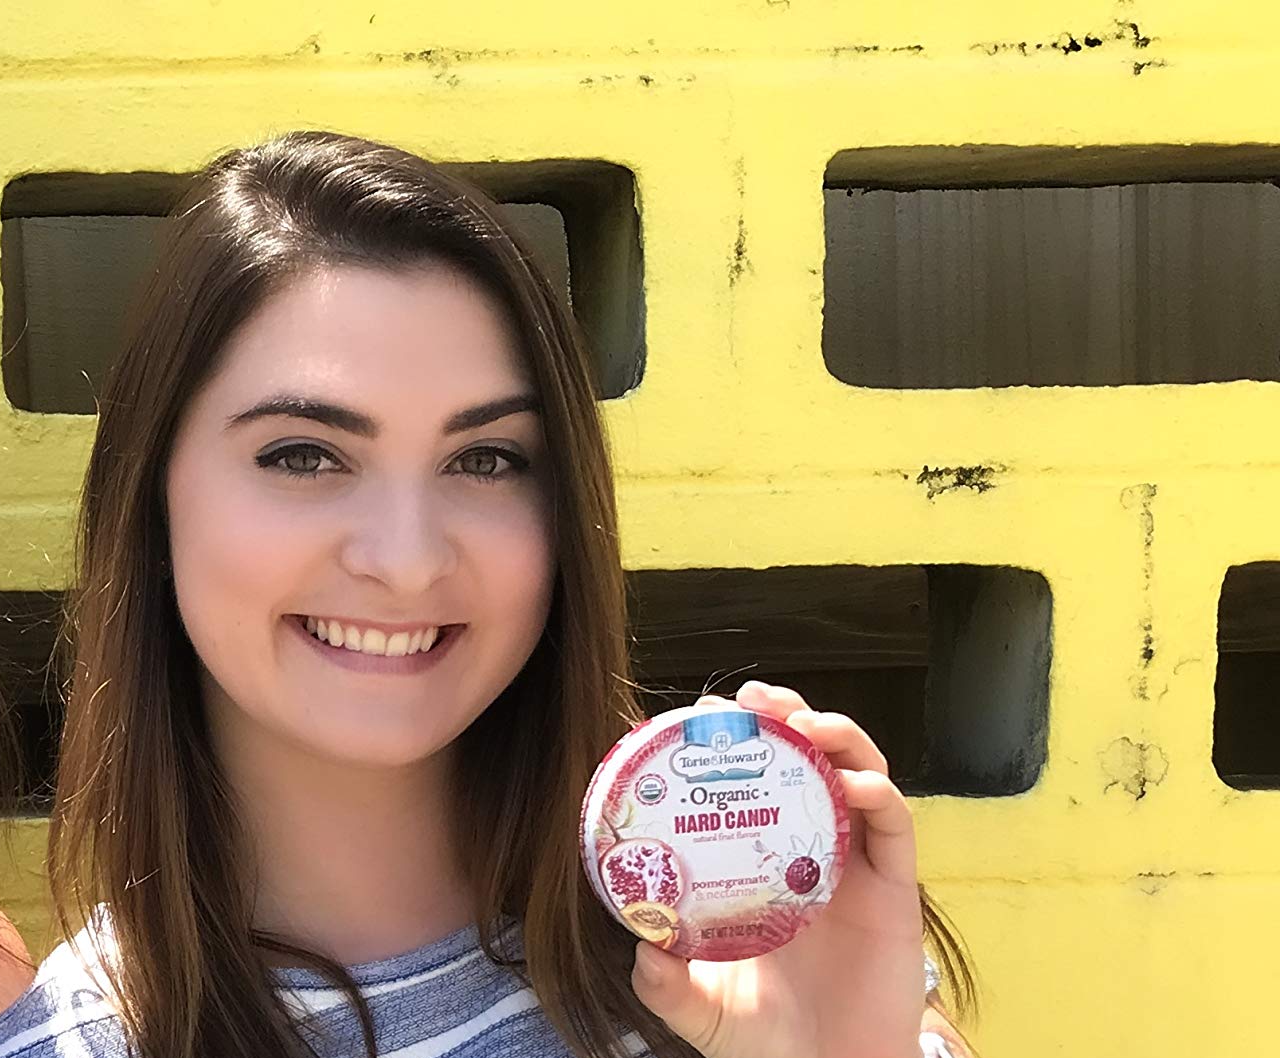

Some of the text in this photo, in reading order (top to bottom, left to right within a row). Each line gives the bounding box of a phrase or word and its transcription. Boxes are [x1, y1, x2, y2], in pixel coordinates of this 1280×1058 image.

[690, 783, 759, 810] Organic
[674, 806, 781, 835] HARD CANDY
[693, 831, 760, 842] natural fruit flavors
[691, 874, 769, 891] pomegranate
[706, 886, 757, 899] nectarine
